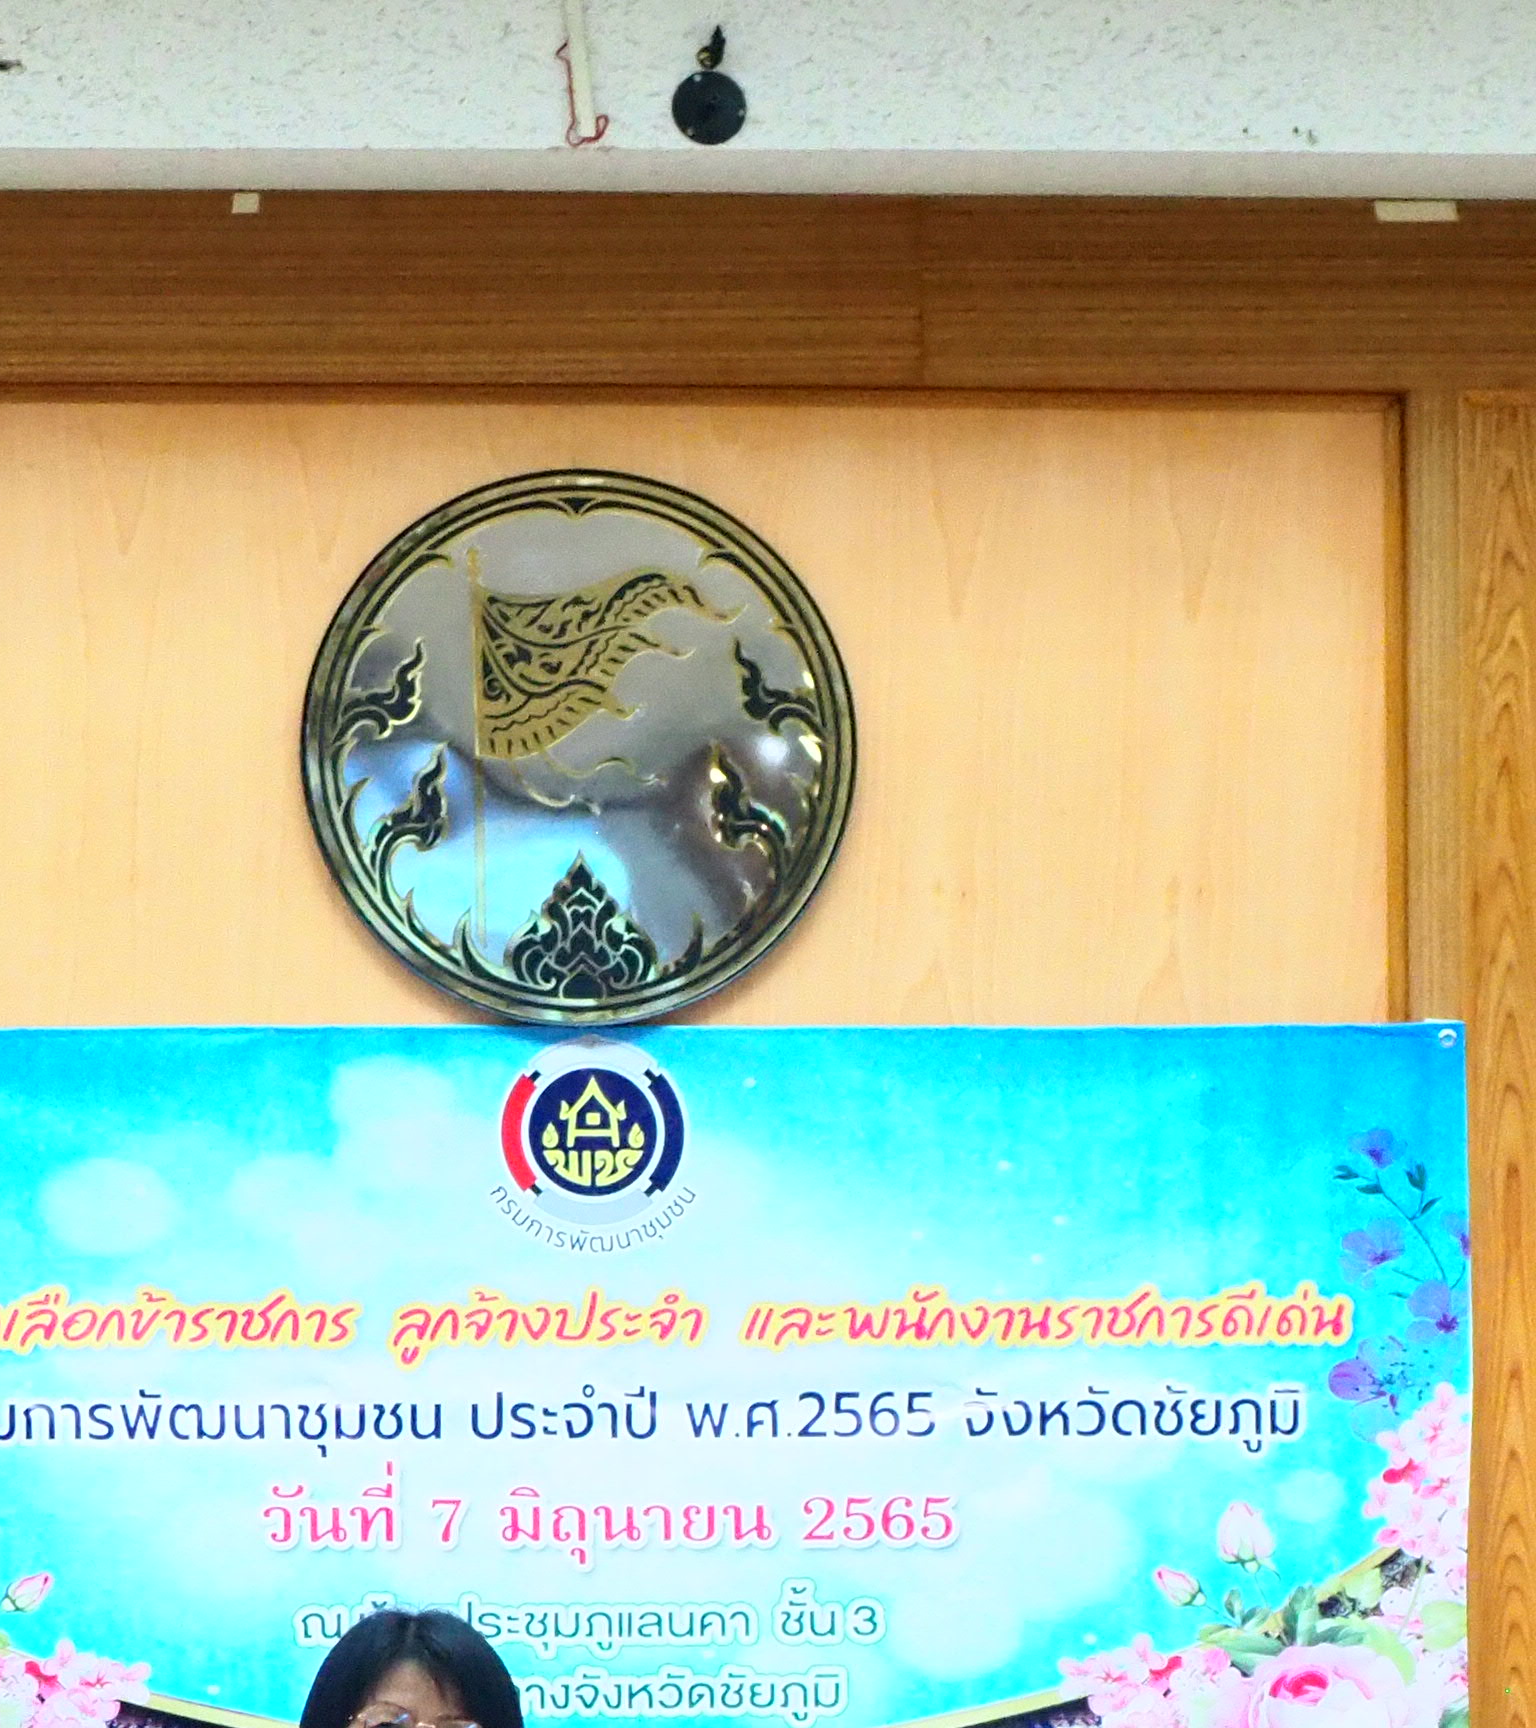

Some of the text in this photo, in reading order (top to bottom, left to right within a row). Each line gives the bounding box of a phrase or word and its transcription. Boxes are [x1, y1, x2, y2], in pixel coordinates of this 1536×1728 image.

[489, 1184, 697, 1254] กรมการพัฒนาชุมชน
[390, 1289, 704, 1367] ลูกจ้างประจำ
[742, 1284, 1348, 1351] และพนักงานราชการดีเด่น
[469, 1384, 659, 1443] ประจำปี
[685, 1389, 936, 1440] พ.ศ.2565
[963, 1386, 1302, 1454] จังหวัดชัยภูมิ
[262, 1460, 957, 1566] วันที่ 7 มิถุนายน 2565
[780, 1585, 836, 1638] ชั้น
[851, 1604, 878, 1638] 3
[516, 1672, 841, 1721] างจังหวัดชัยภูมิ
